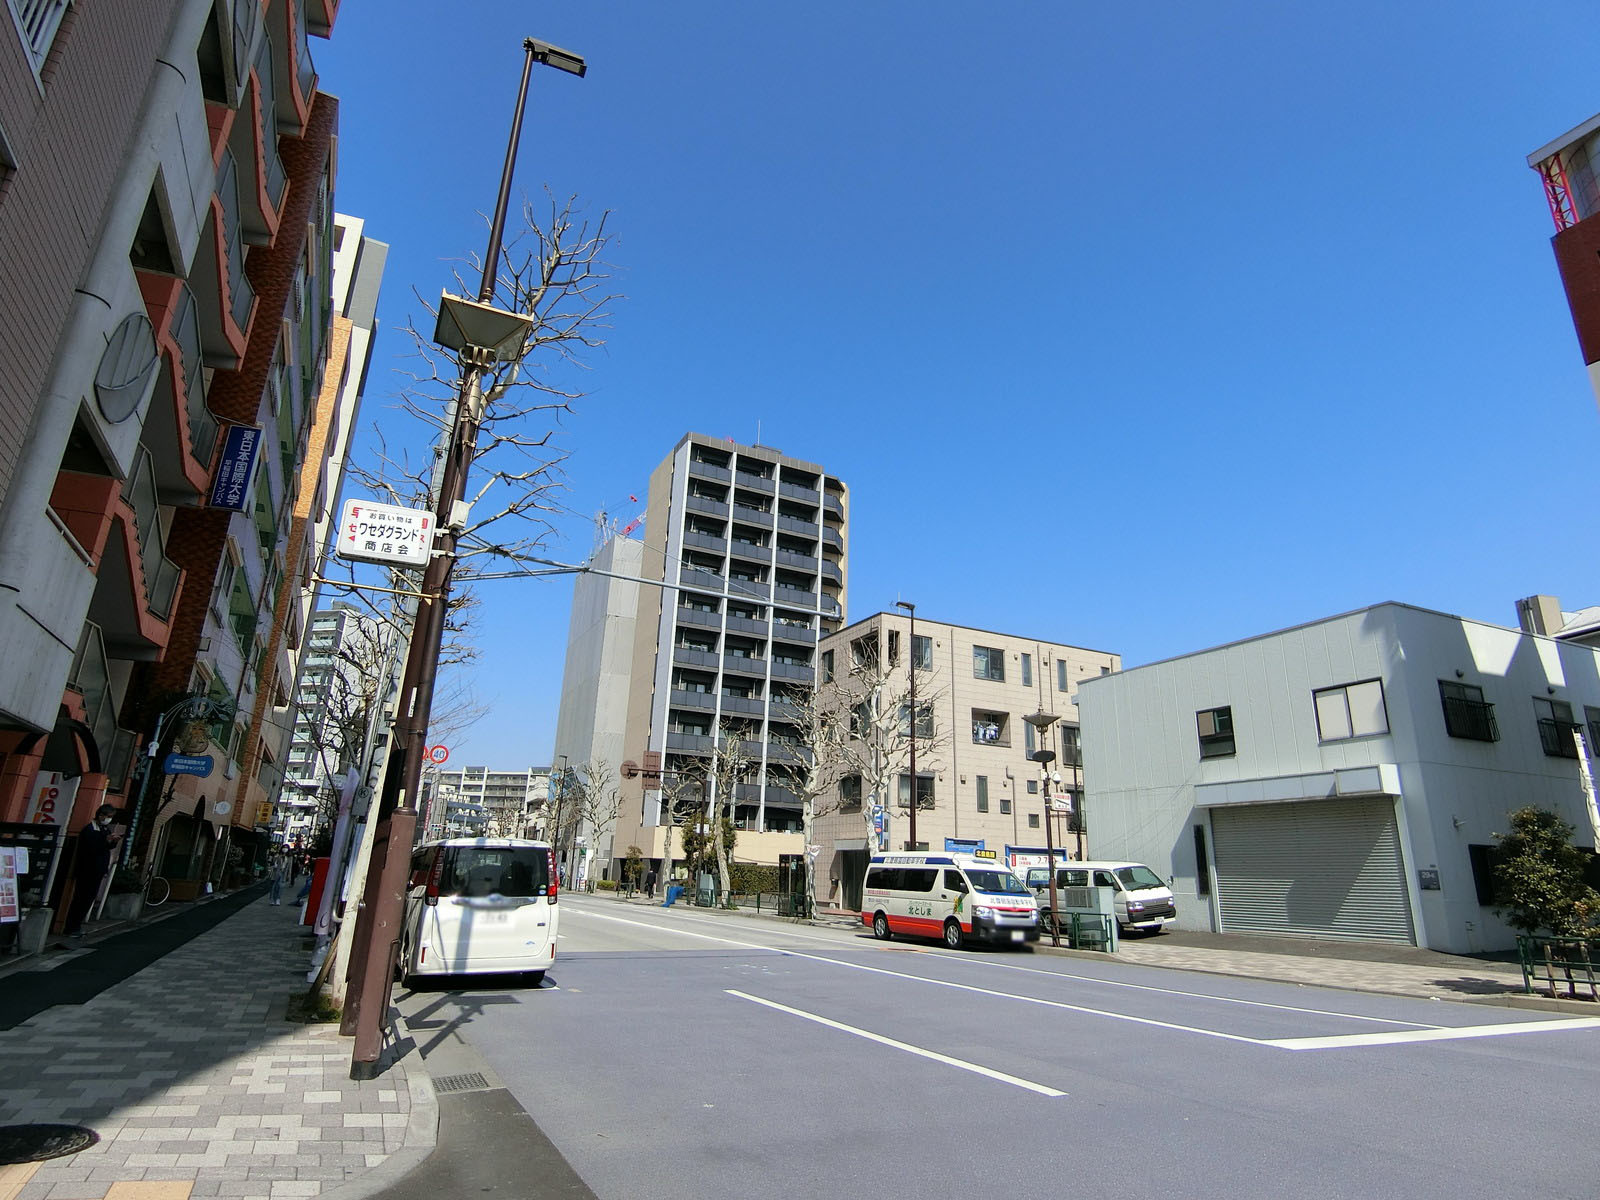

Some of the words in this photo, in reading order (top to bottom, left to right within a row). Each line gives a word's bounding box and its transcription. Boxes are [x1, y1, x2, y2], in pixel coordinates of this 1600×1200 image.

[226, 430, 256, 506] 東日本国際大学
[369, 512, 413, 524] お買い物は
[359, 522, 419, 542] ワセダグランド
[364, 540, 409, 555] 商店会
[433, 750, 445, 759] 40
[40, 787, 60, 824] yDo
[908, 906, 932, 916] 北としま
